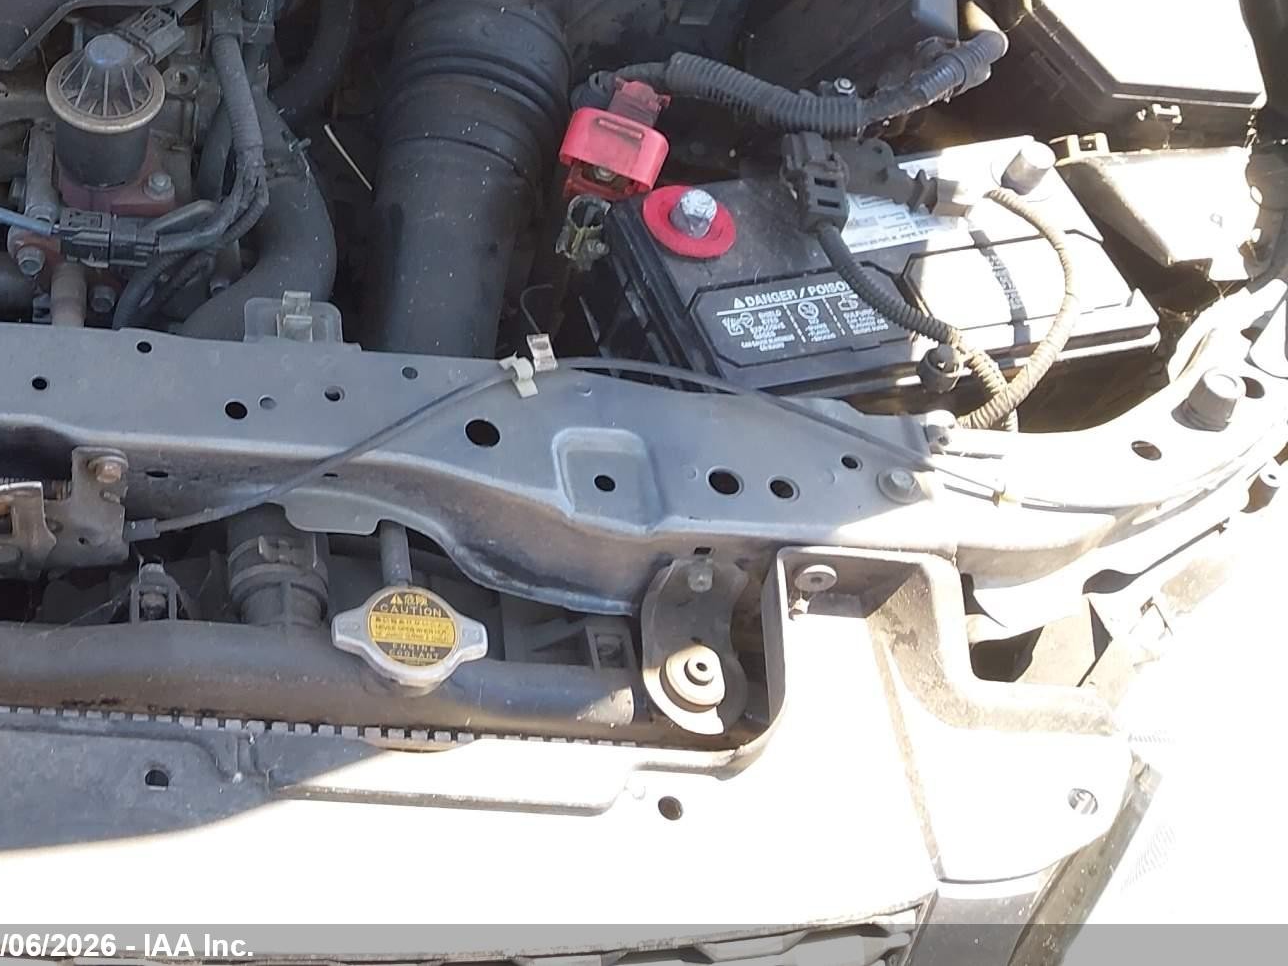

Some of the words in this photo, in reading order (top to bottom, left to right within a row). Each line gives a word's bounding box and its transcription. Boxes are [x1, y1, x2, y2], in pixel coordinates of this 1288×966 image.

[745, 288, 797, 307] DANGER
[380, 602, 442, 618] CAUTION
[388, 649, 439, 660] COOLANT
